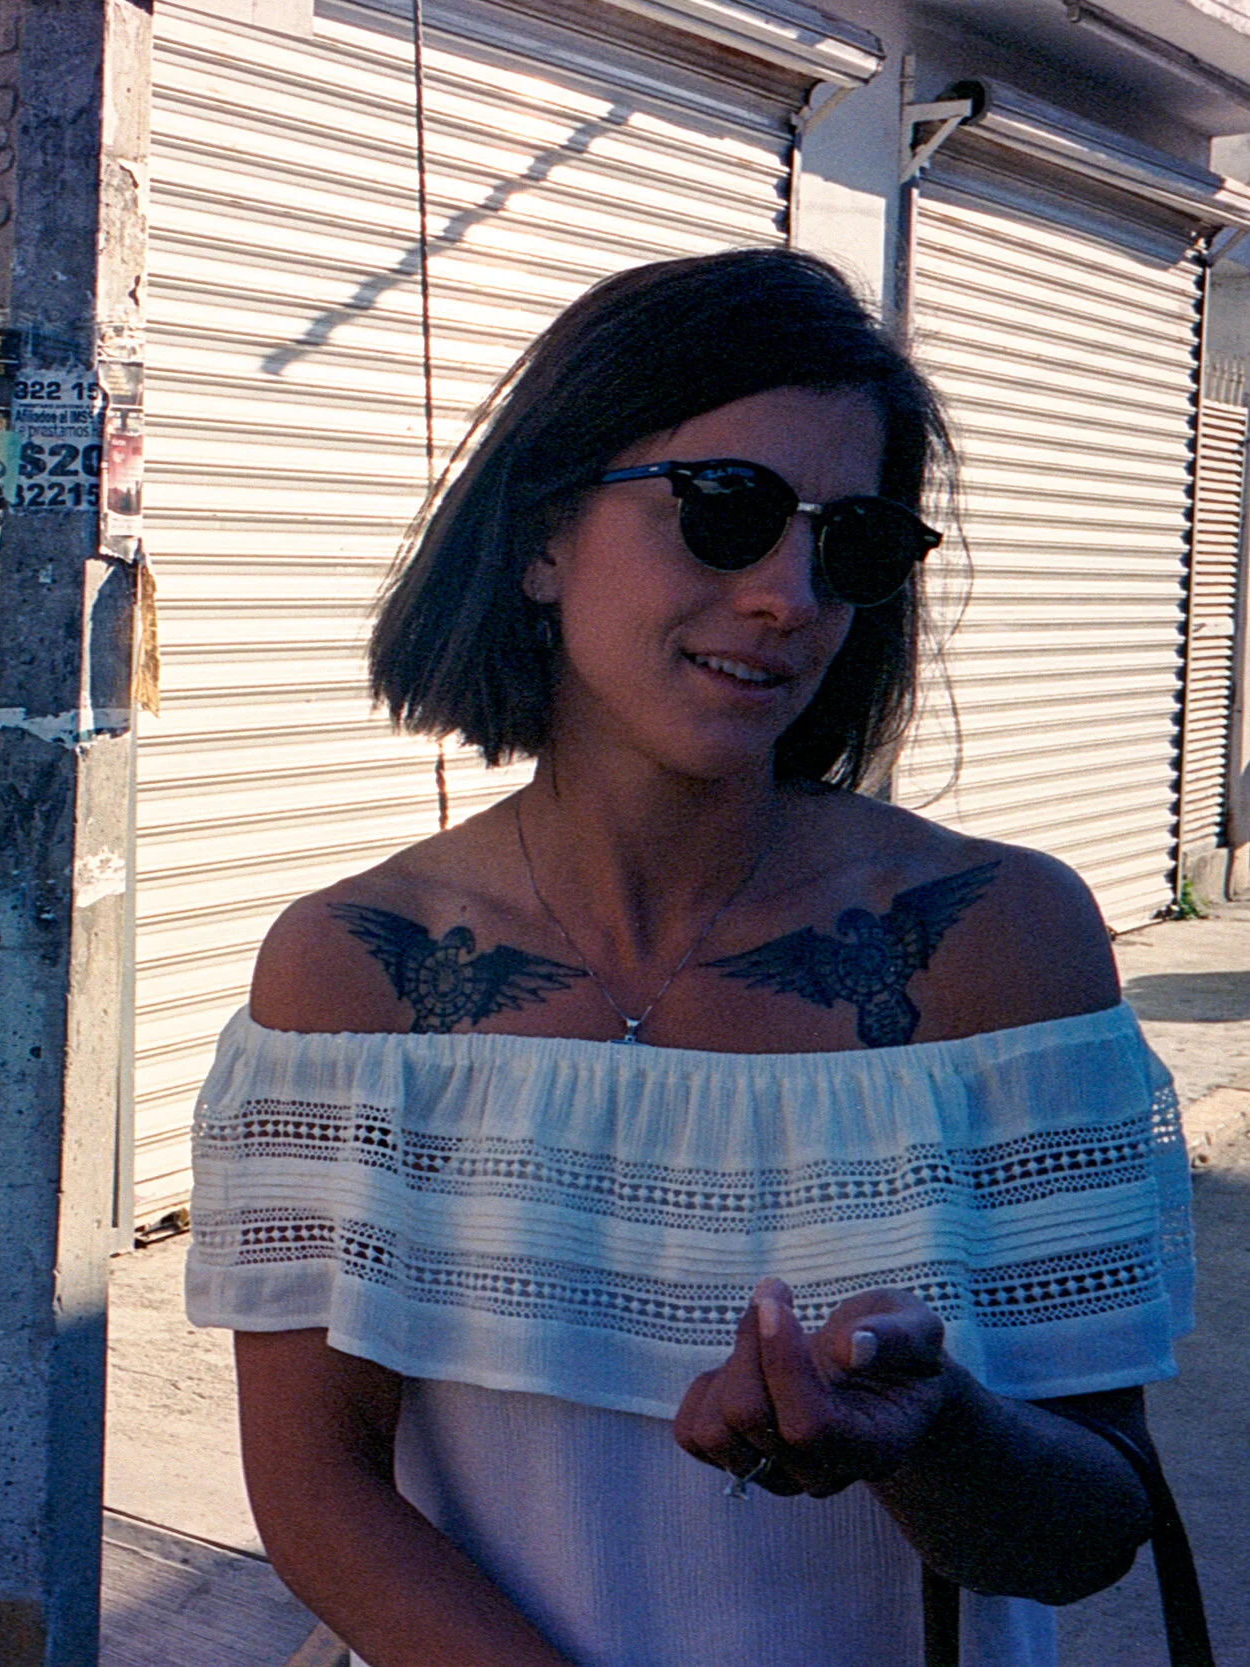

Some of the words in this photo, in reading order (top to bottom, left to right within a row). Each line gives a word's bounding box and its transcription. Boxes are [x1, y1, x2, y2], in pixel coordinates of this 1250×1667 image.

[14, 380, 62, 400] 322
[13, 409, 57, 424] Afiliados
[58, 410, 68, 424] al
